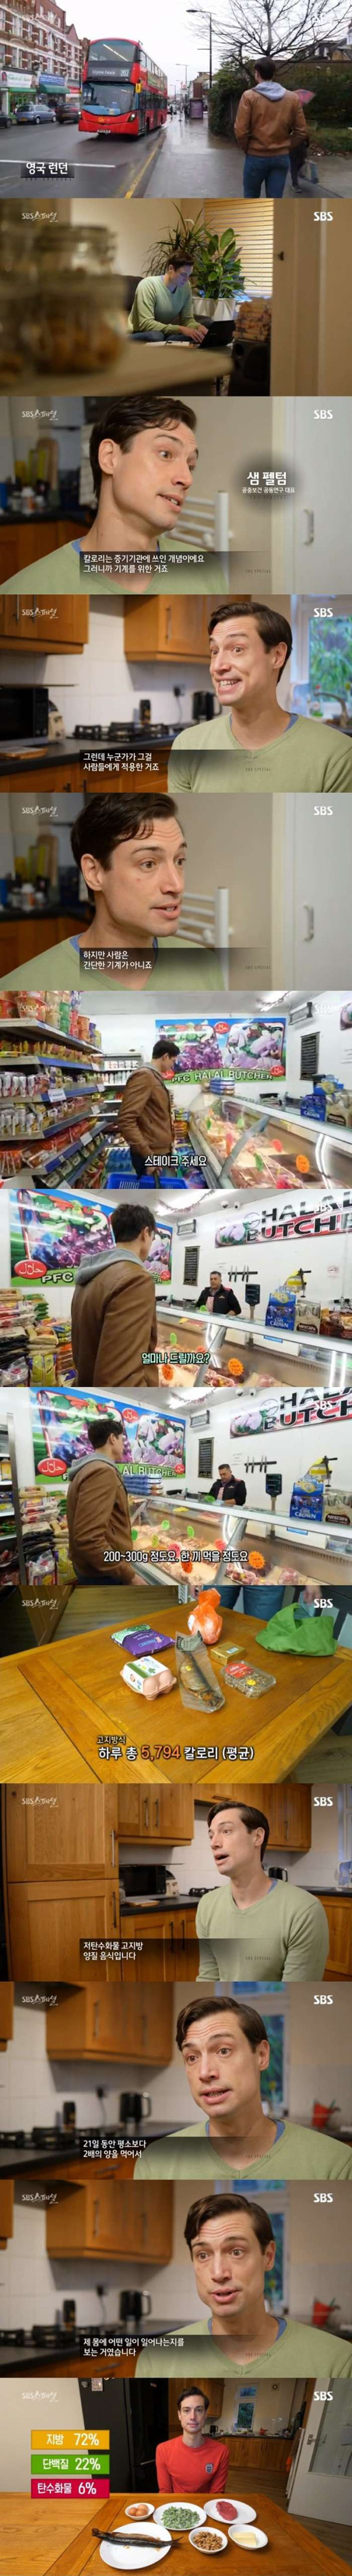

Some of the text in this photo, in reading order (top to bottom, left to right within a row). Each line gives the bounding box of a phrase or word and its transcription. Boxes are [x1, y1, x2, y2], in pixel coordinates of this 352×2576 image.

[171, 1070, 273, 1083] PFC HALAL BUTCHER
[42, 1272, 74, 1284] PFC
[136, 1465, 177, 1477] BUTCHER
